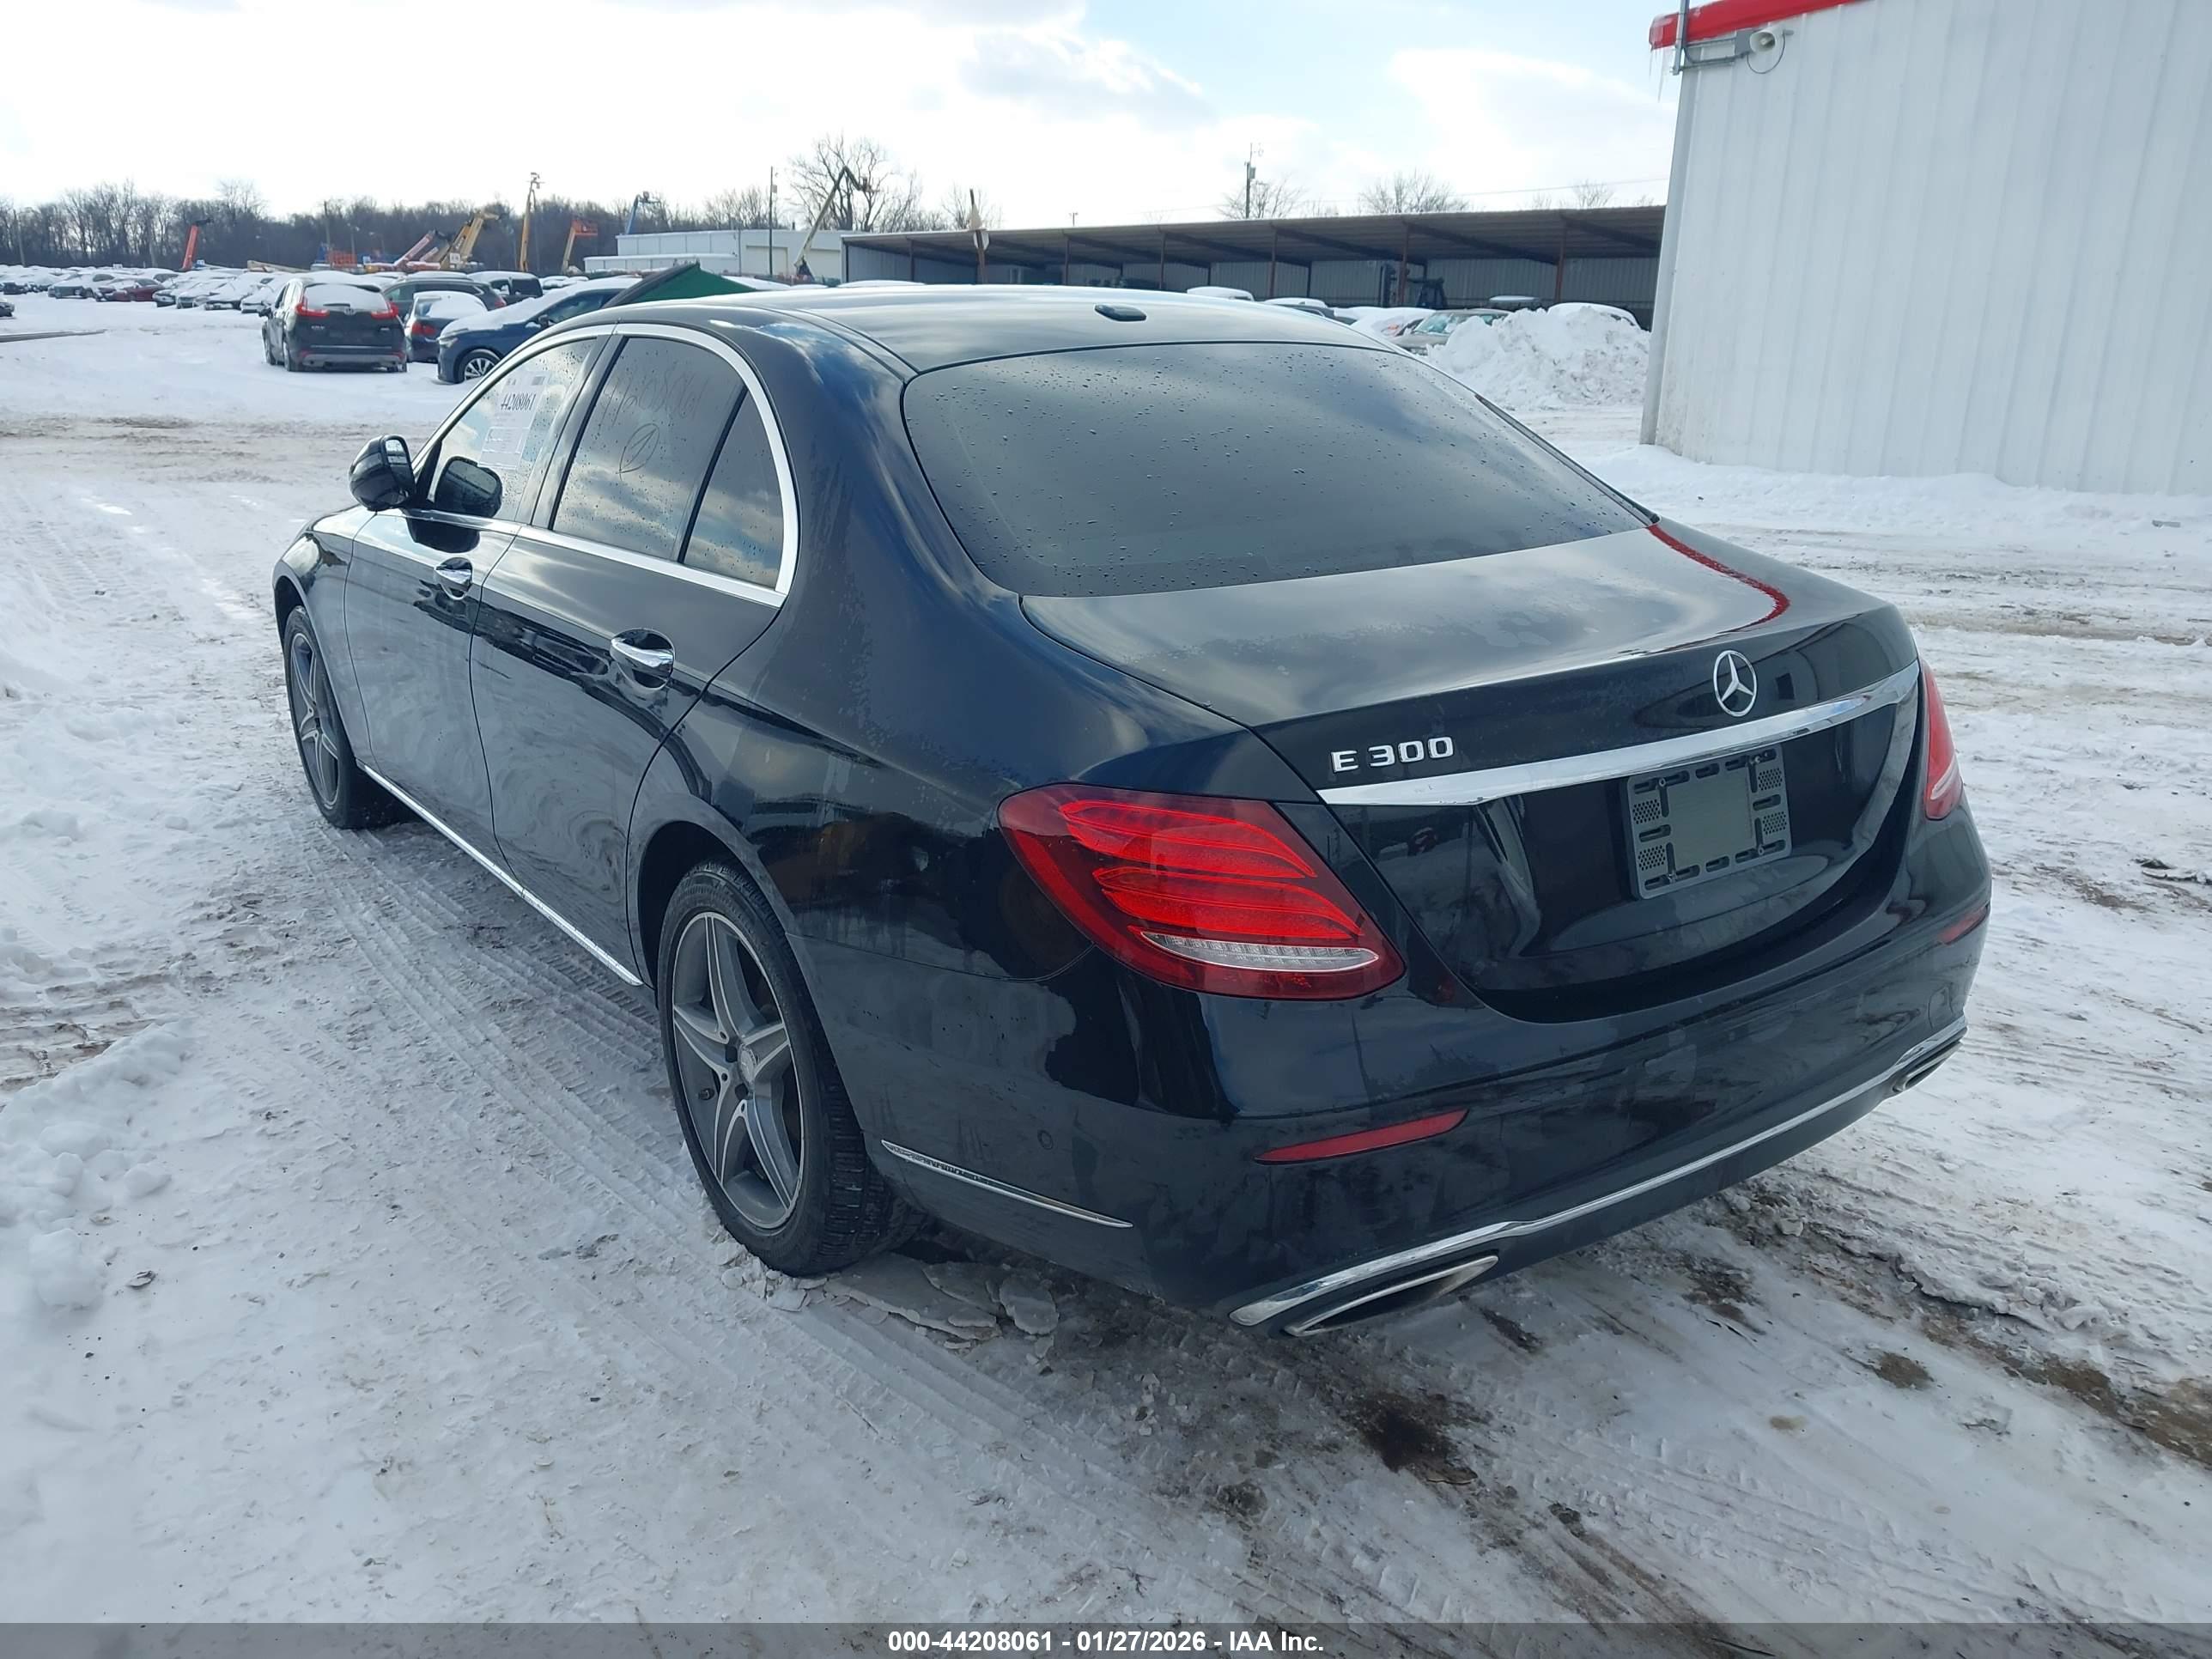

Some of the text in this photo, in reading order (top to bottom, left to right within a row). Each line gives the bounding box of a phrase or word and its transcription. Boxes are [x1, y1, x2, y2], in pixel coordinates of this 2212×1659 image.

[501, 392, 537, 410] 44208061
[1331, 736, 1454, 773] E 300
